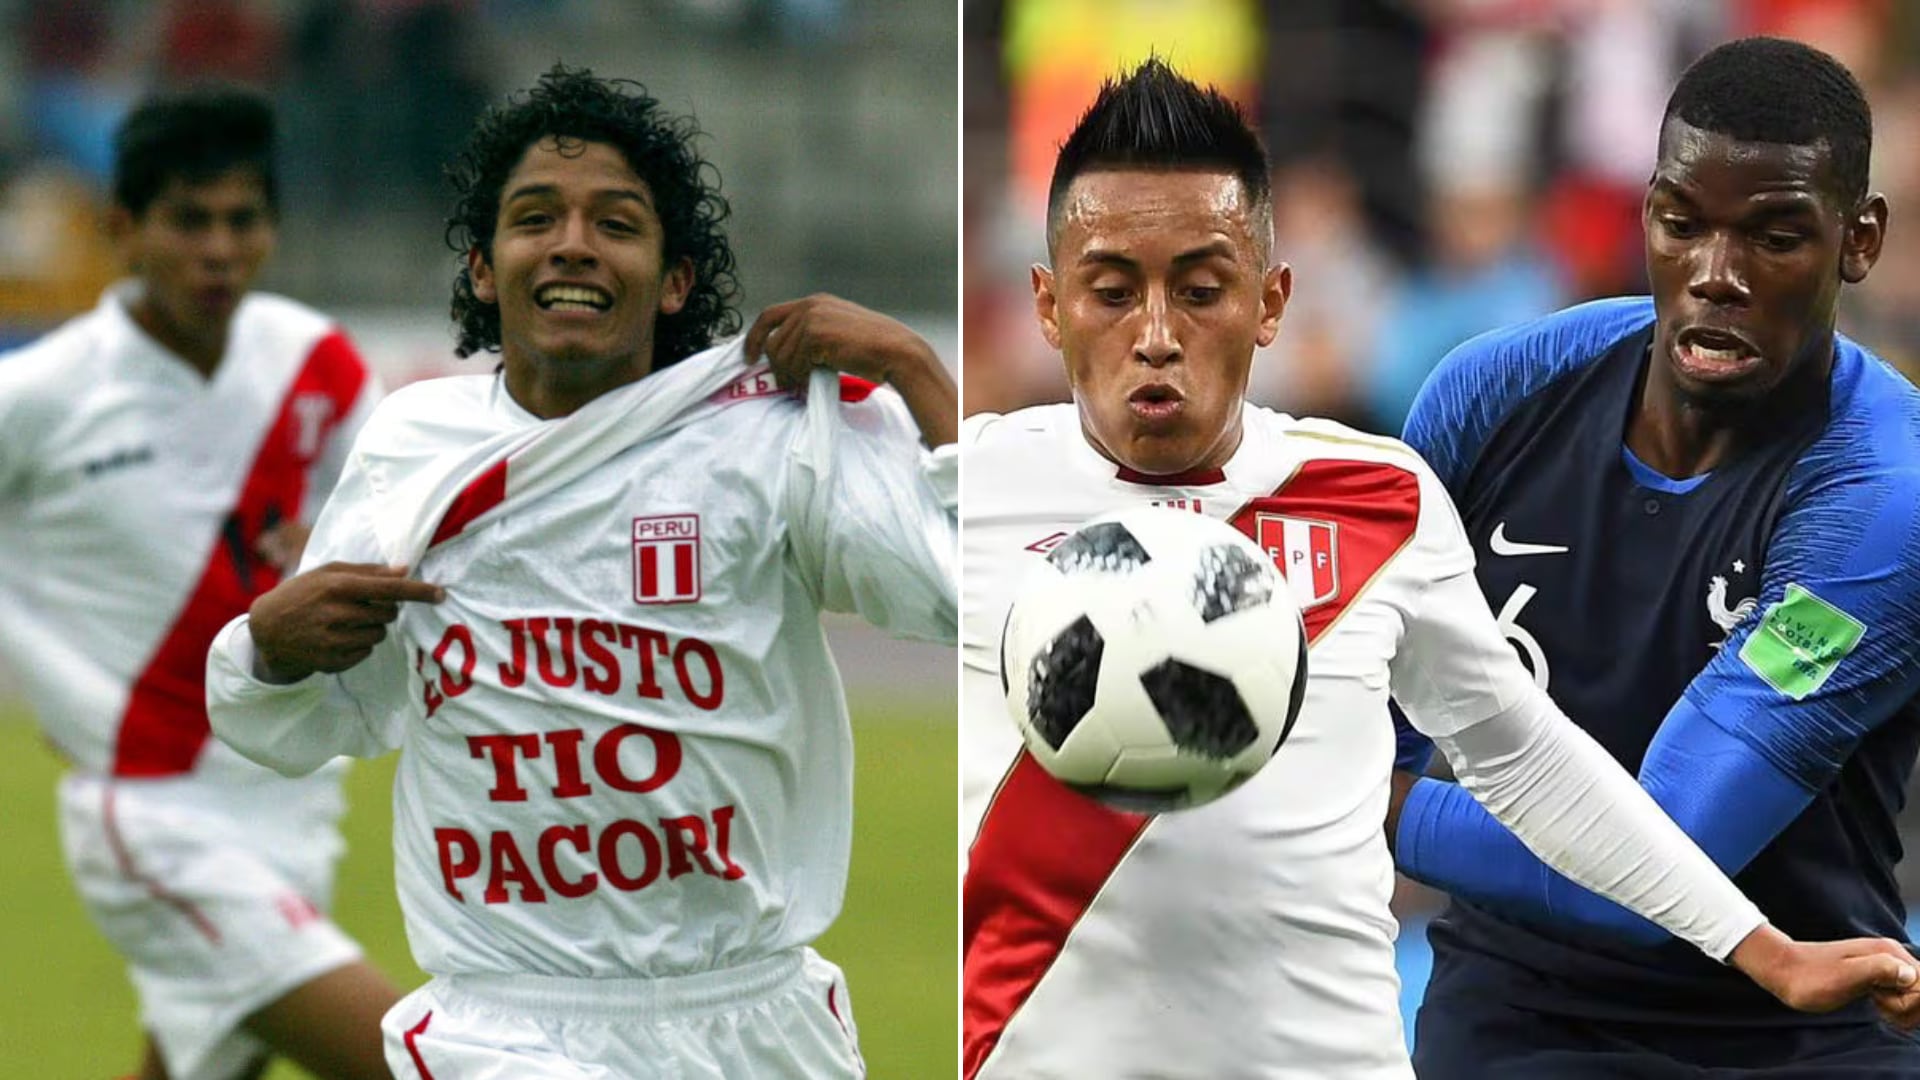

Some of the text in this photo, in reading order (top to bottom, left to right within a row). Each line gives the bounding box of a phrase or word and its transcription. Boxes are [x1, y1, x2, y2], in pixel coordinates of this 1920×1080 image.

[639, 520, 693, 536] PERU
[497, 617, 724, 711] JUSTO
[466, 723, 683, 802] TIO
[434, 805, 746, 904] PACORI
